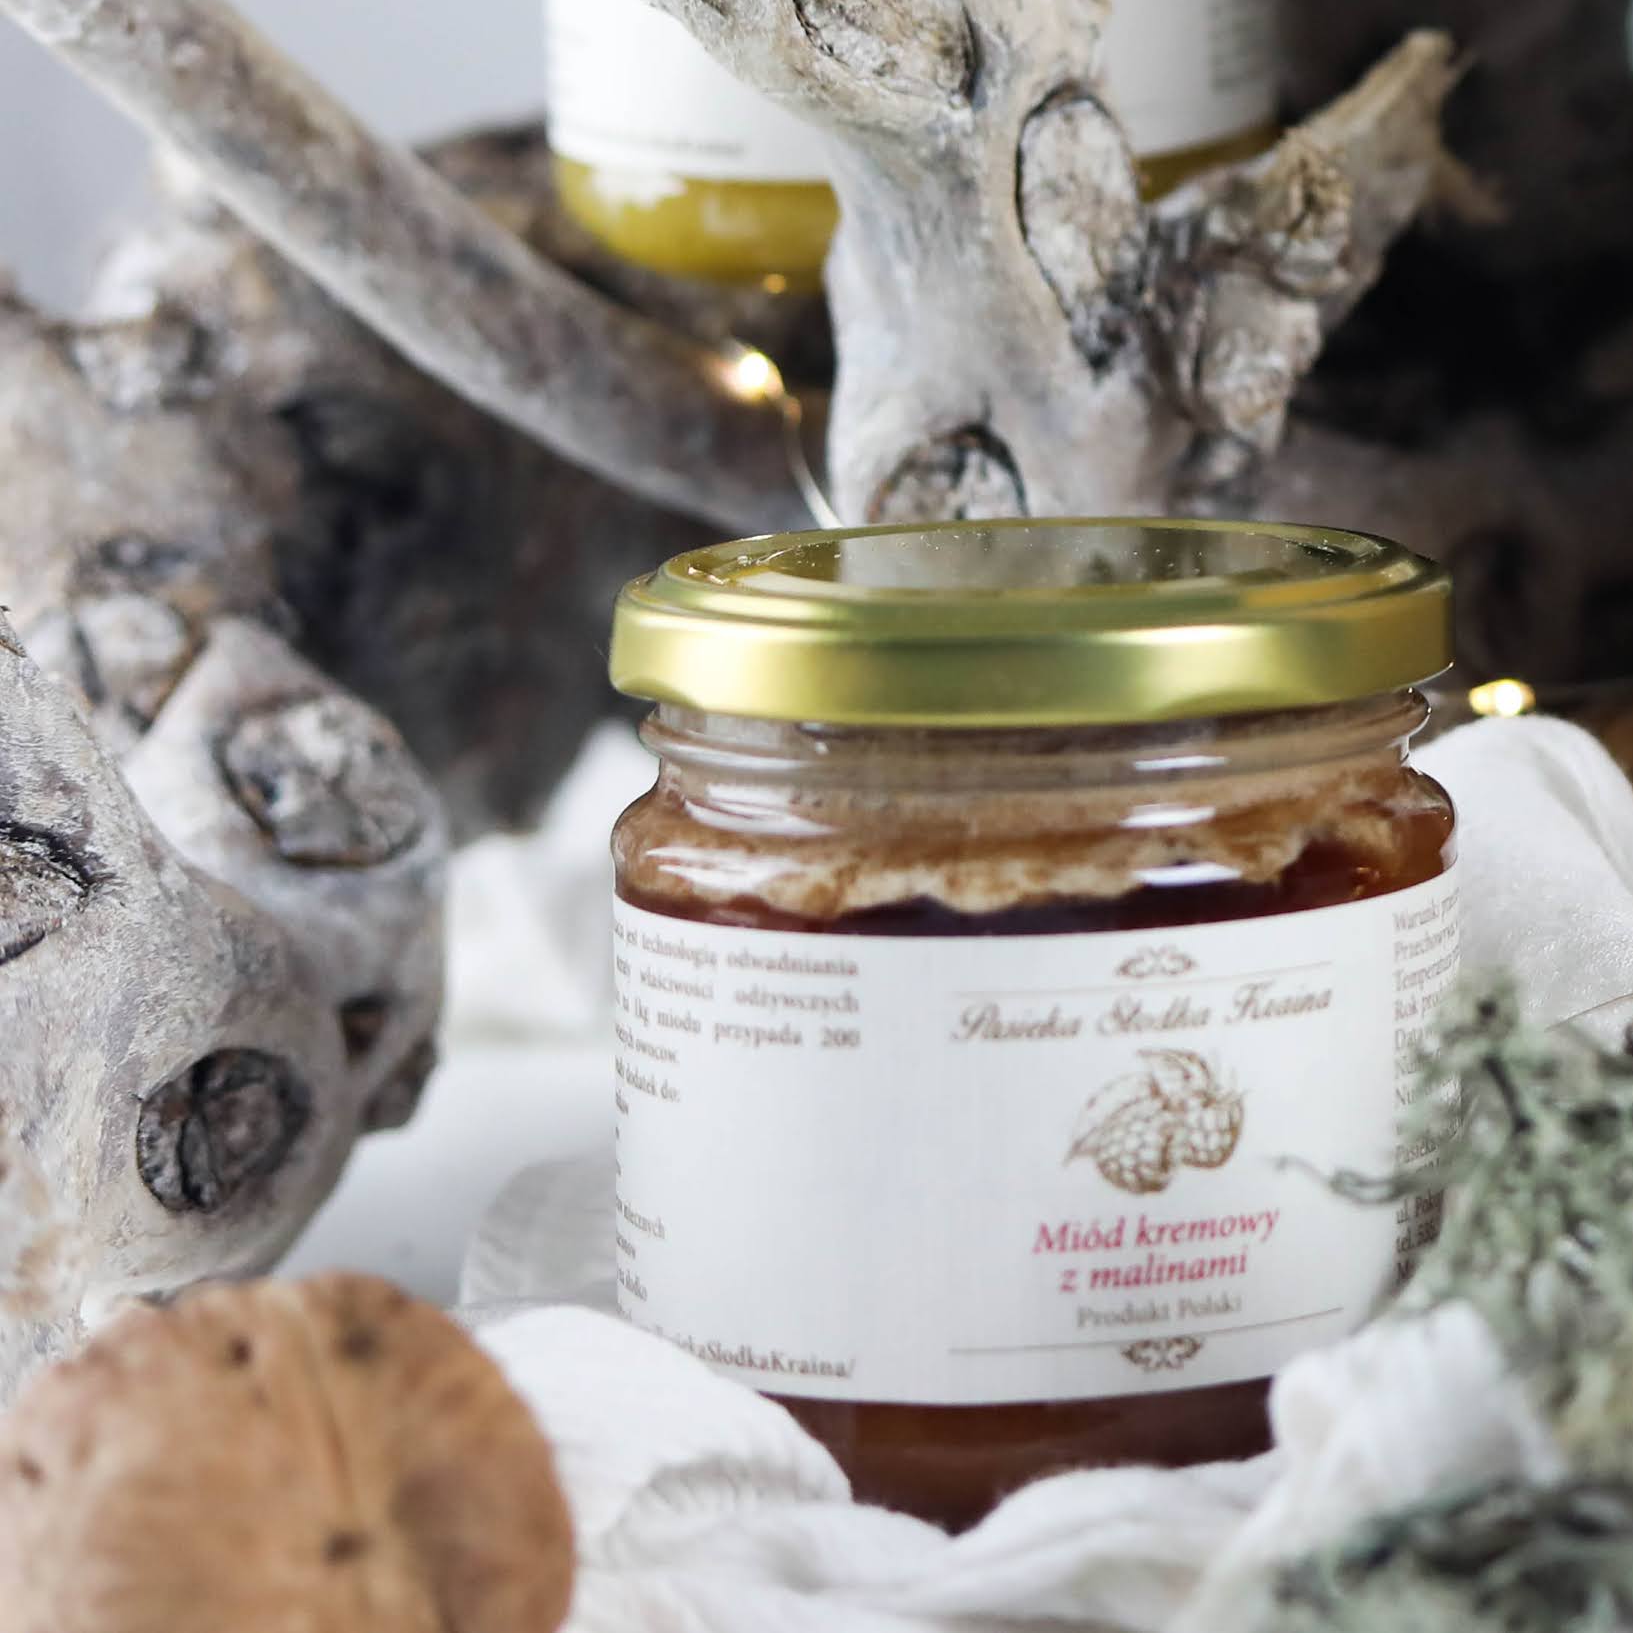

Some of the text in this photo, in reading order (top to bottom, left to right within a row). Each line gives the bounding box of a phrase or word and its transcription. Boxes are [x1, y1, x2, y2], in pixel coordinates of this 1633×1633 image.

[726, 945, 860, 977] odwadniania
[713, 1019, 804, 1049] przypada
[820, 1025, 861, 1049] 200
[1031, 1207, 1281, 1256] Miód kremowy
[1058, 1245, 1249, 1294] z malinami
